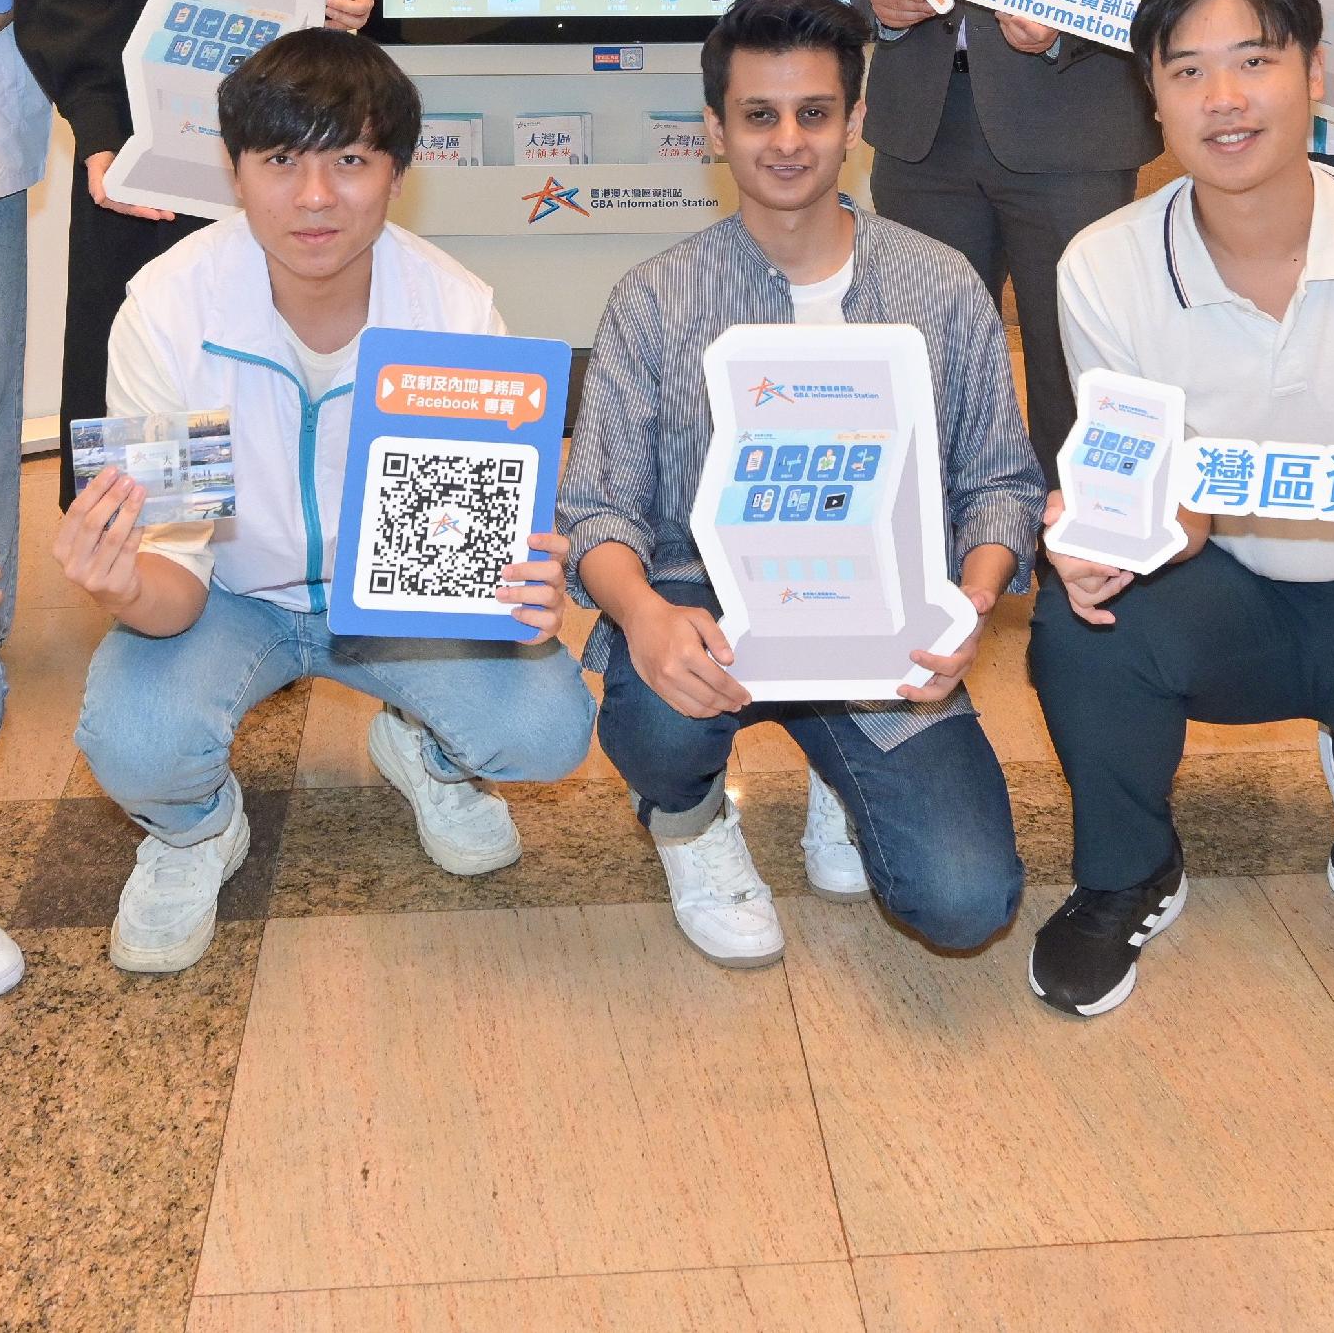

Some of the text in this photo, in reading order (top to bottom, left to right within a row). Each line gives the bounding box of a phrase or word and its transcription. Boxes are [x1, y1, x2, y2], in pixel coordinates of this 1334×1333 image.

[526, 132, 571, 146] 大灣區
[591, 198, 718, 209] GBA Information Station
[401, 374, 524, 397] 政制及內地事務局
[407, 394, 479, 410] Facebook
